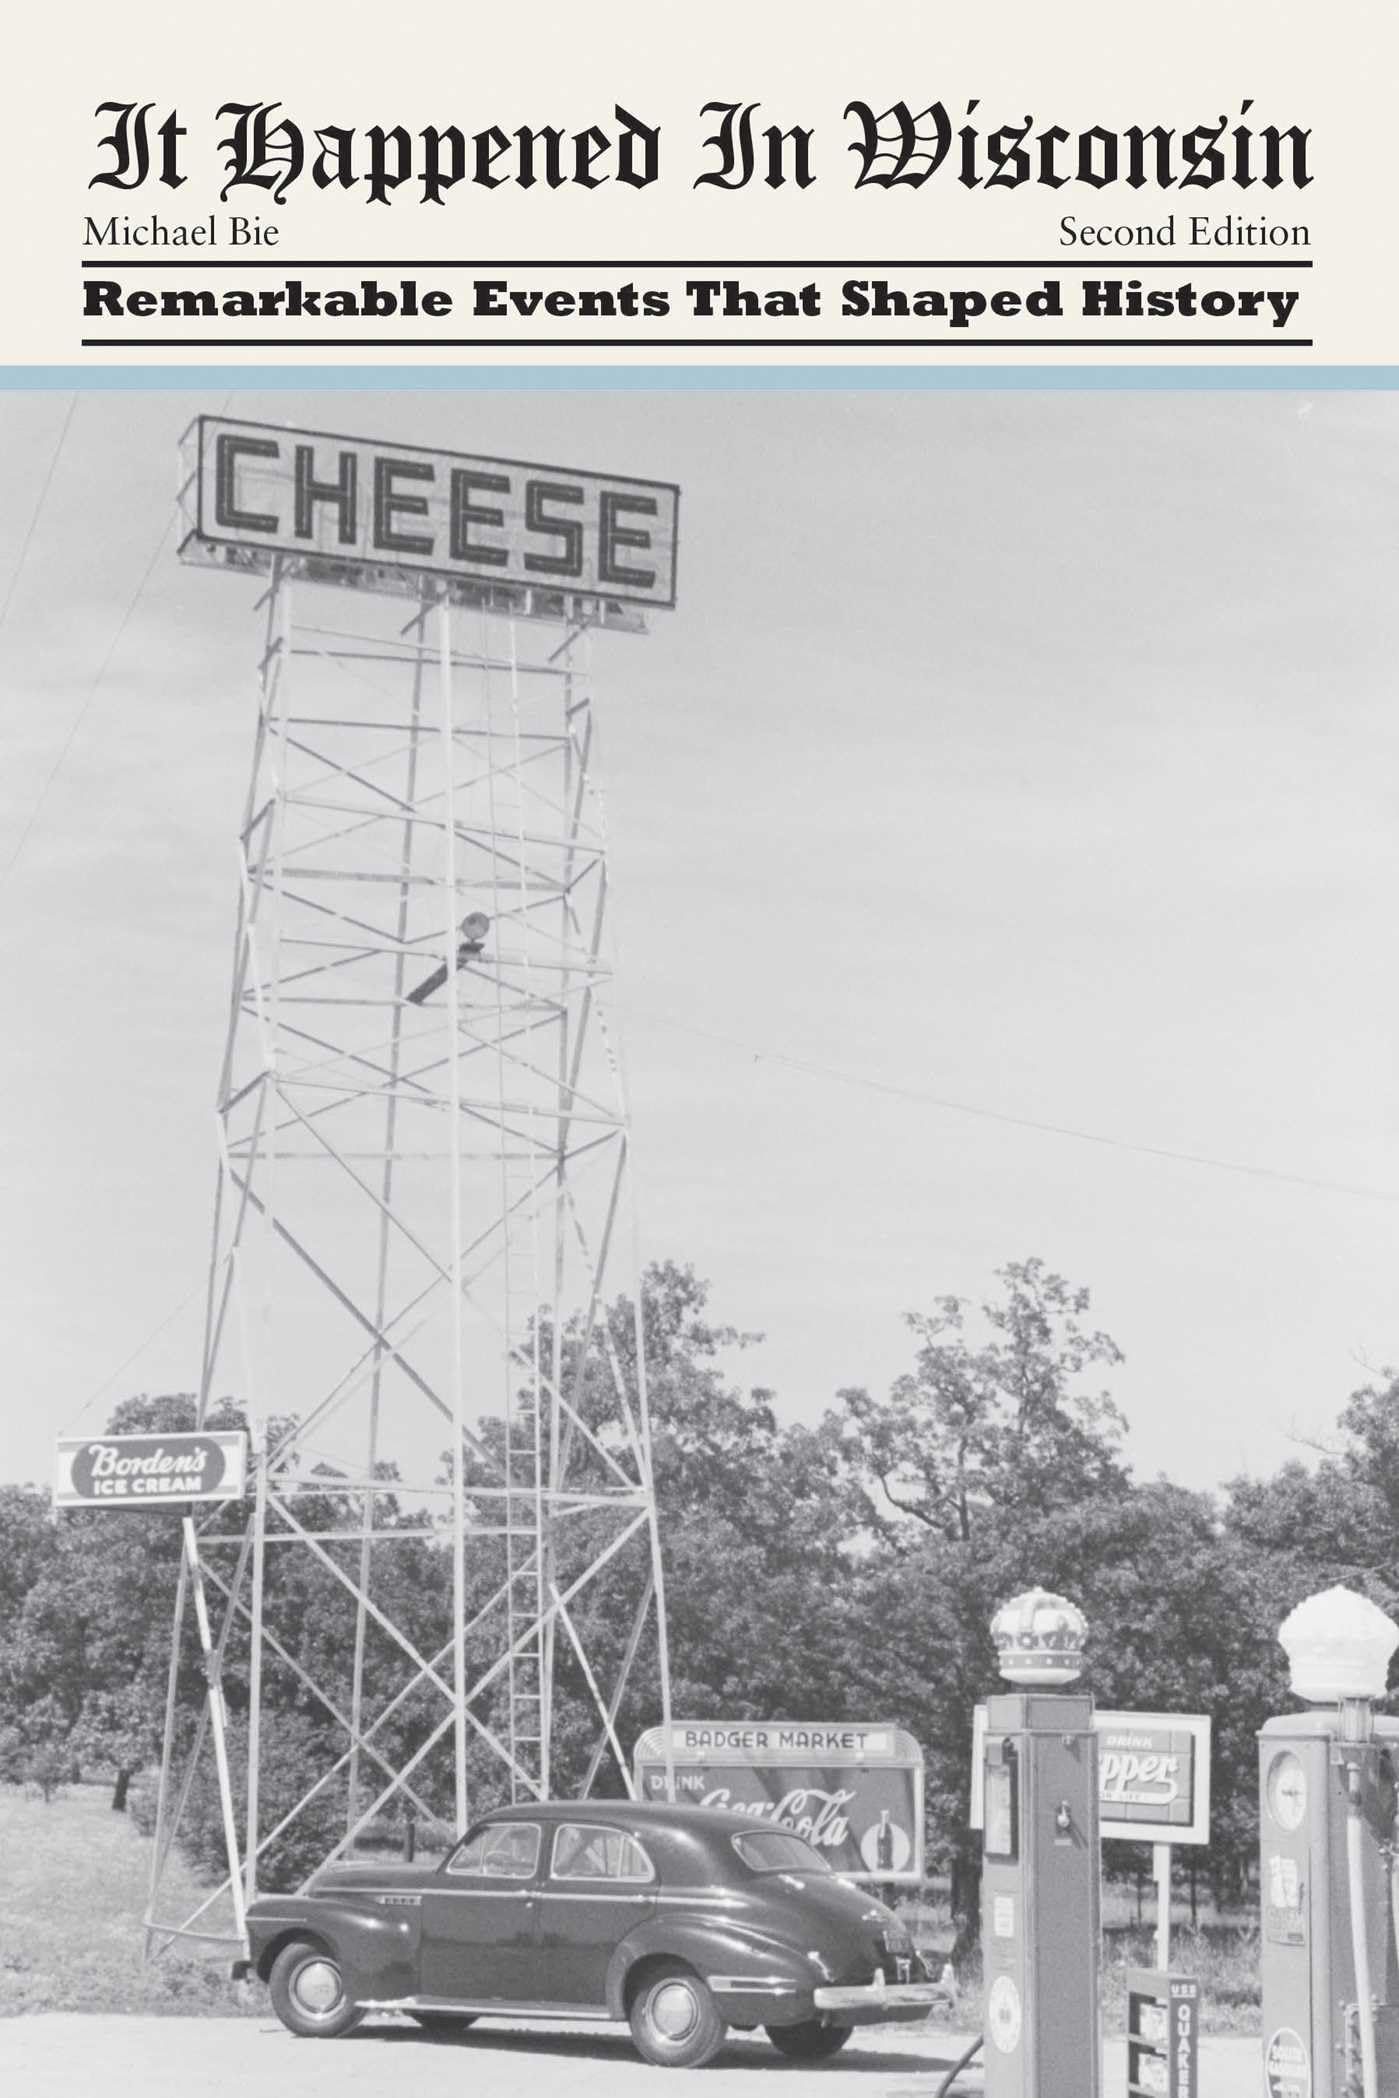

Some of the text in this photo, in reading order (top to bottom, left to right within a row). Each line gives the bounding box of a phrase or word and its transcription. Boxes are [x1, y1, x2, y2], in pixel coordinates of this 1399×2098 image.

[215, 433, 658, 589] CHEESE
[88, 1444, 208, 1477] Borden's
[93, 1475, 202, 1496] ICE CREAM
[685, 1730, 869, 1749] BADGER MARKET
[651, 1775, 705, 1791] DINK
[1098, 1752, 1179, 1799] pper
[700, 1788, 856, 1846] Ca-Cola
